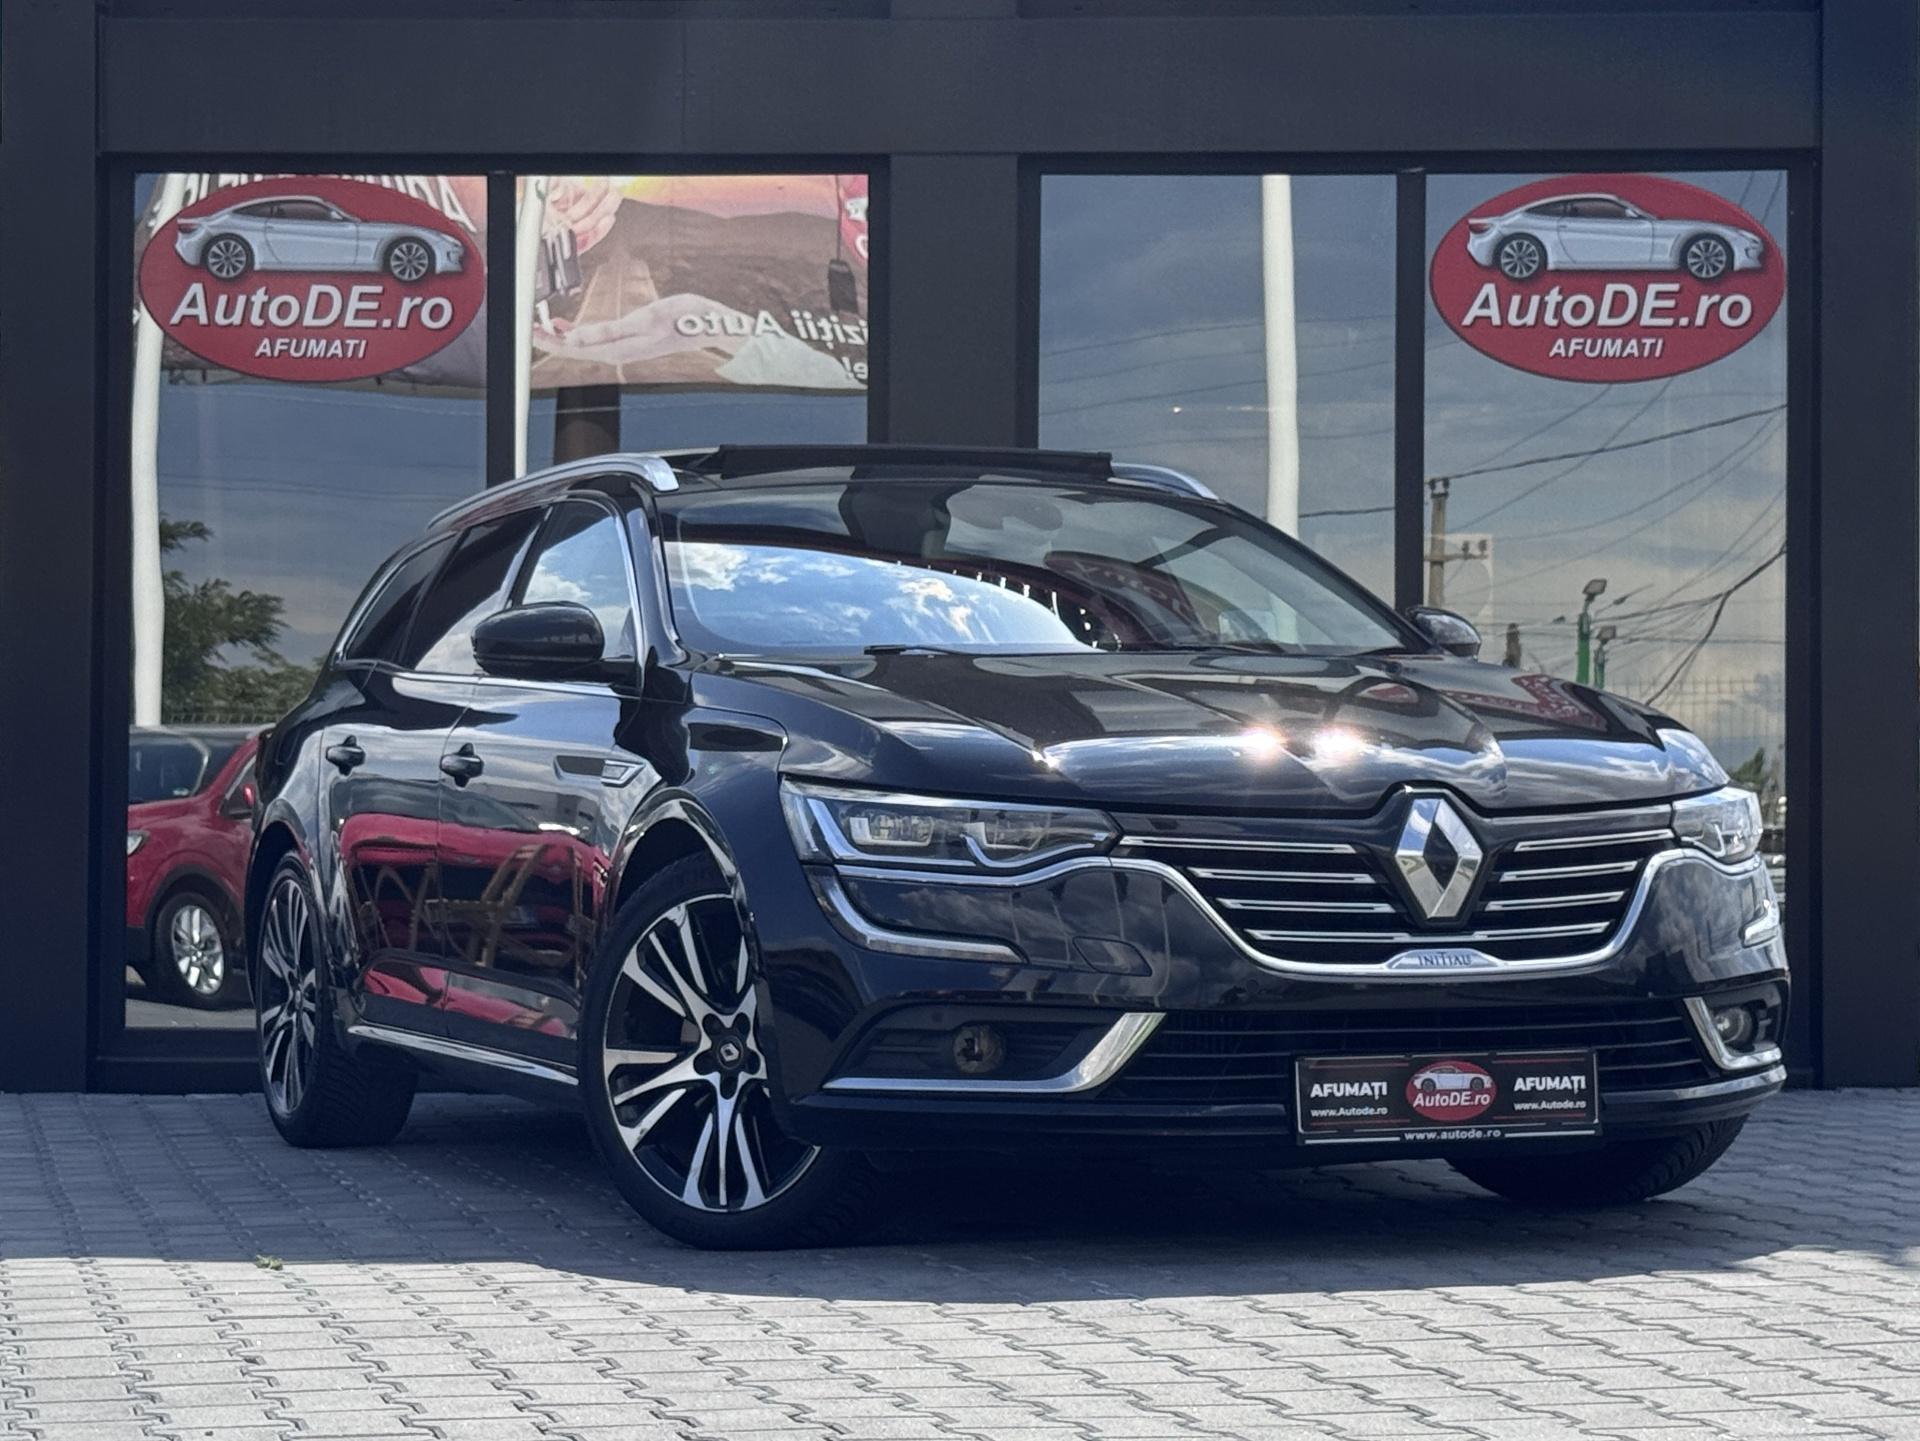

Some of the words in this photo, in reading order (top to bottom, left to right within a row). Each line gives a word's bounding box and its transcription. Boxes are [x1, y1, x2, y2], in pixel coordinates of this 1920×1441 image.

[169, 282, 453, 329] AutoDE.ro
[1461, 282, 1752, 327] AutoDE.ro
[255, 338, 367, 358] AFUMATI
[1549, 338, 1663, 358] AFUMATI
[1413, 1091, 1490, 1108] AutoDE.ro
[1513, 1099, 1587, 1111] www.Autode.ro
[1310, 1106, 1388, 1117] www.Autode.ro
[1404, 1128, 1501, 1141] www.autode.ro
